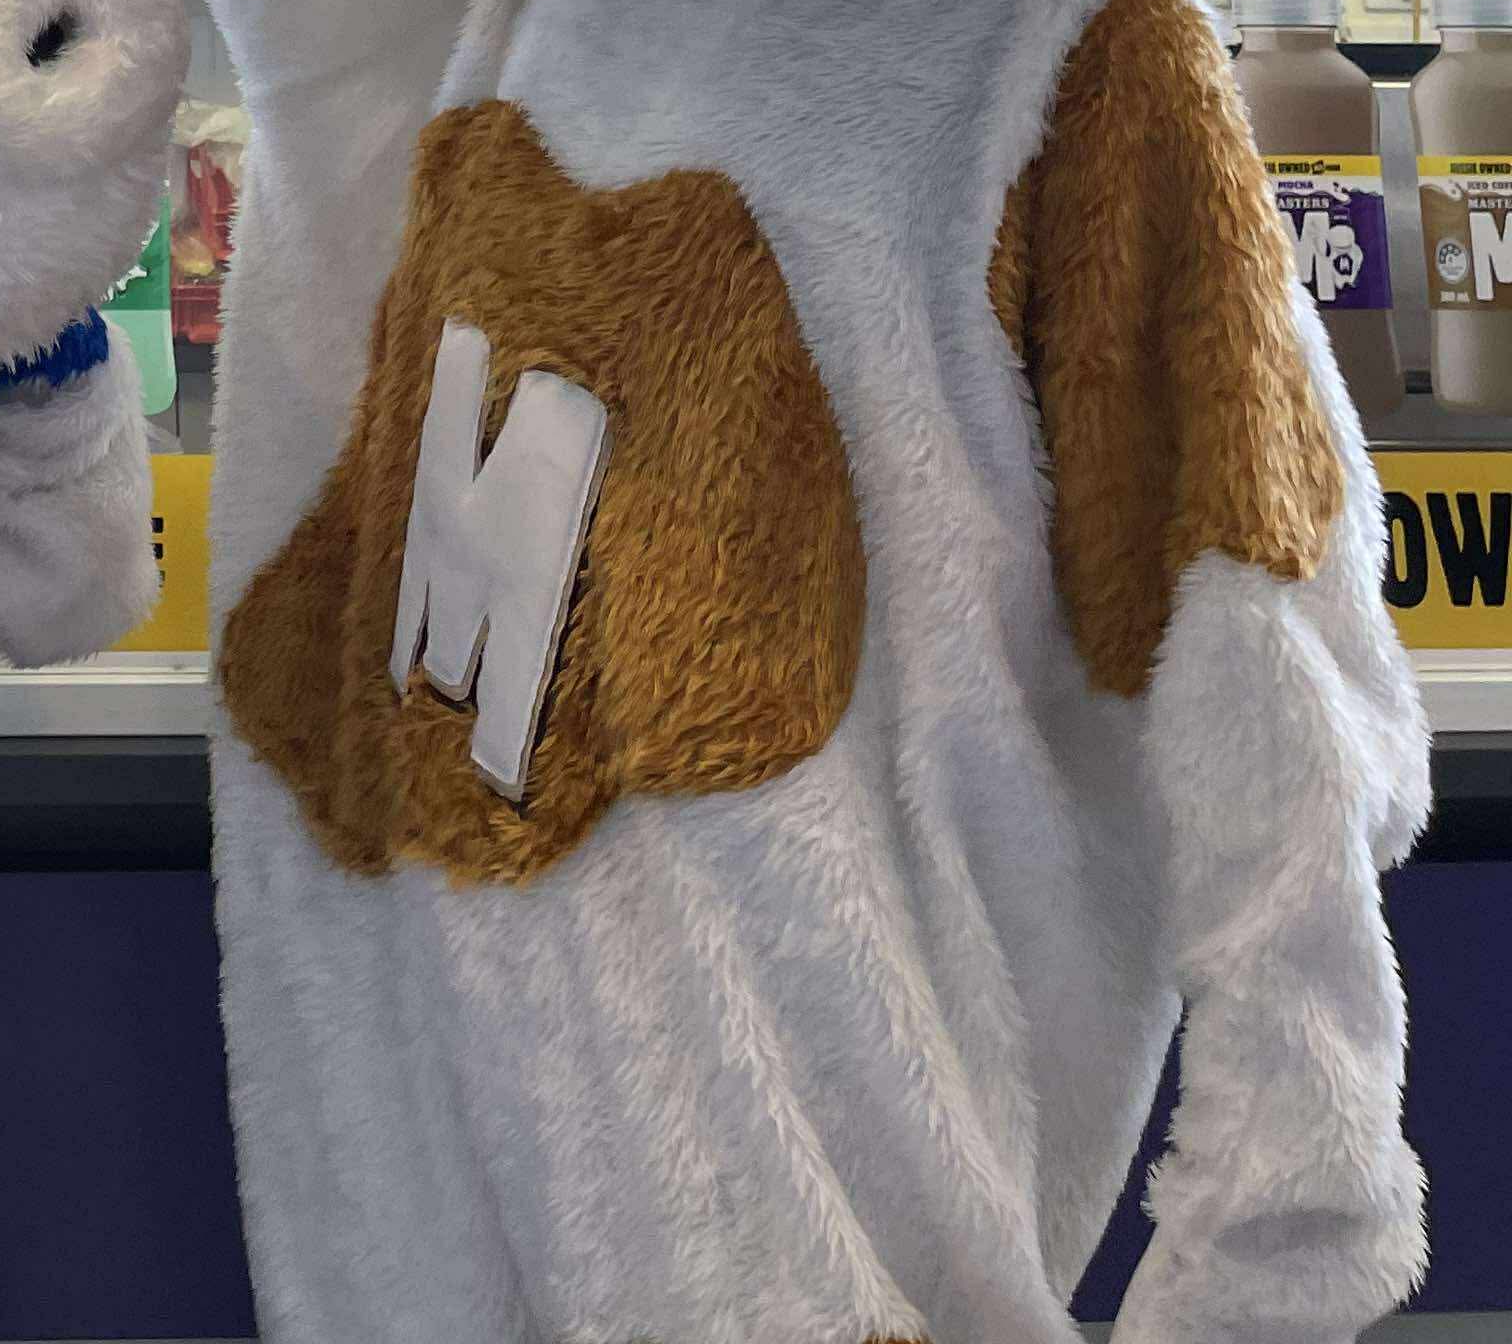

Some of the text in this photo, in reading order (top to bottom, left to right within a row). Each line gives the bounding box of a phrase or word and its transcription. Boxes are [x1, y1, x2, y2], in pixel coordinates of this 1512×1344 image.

[1278, 180, 1313, 189] MOCHA
[1276, 197, 1329, 209] ASTERS
[391, 315, 610, 804] M
